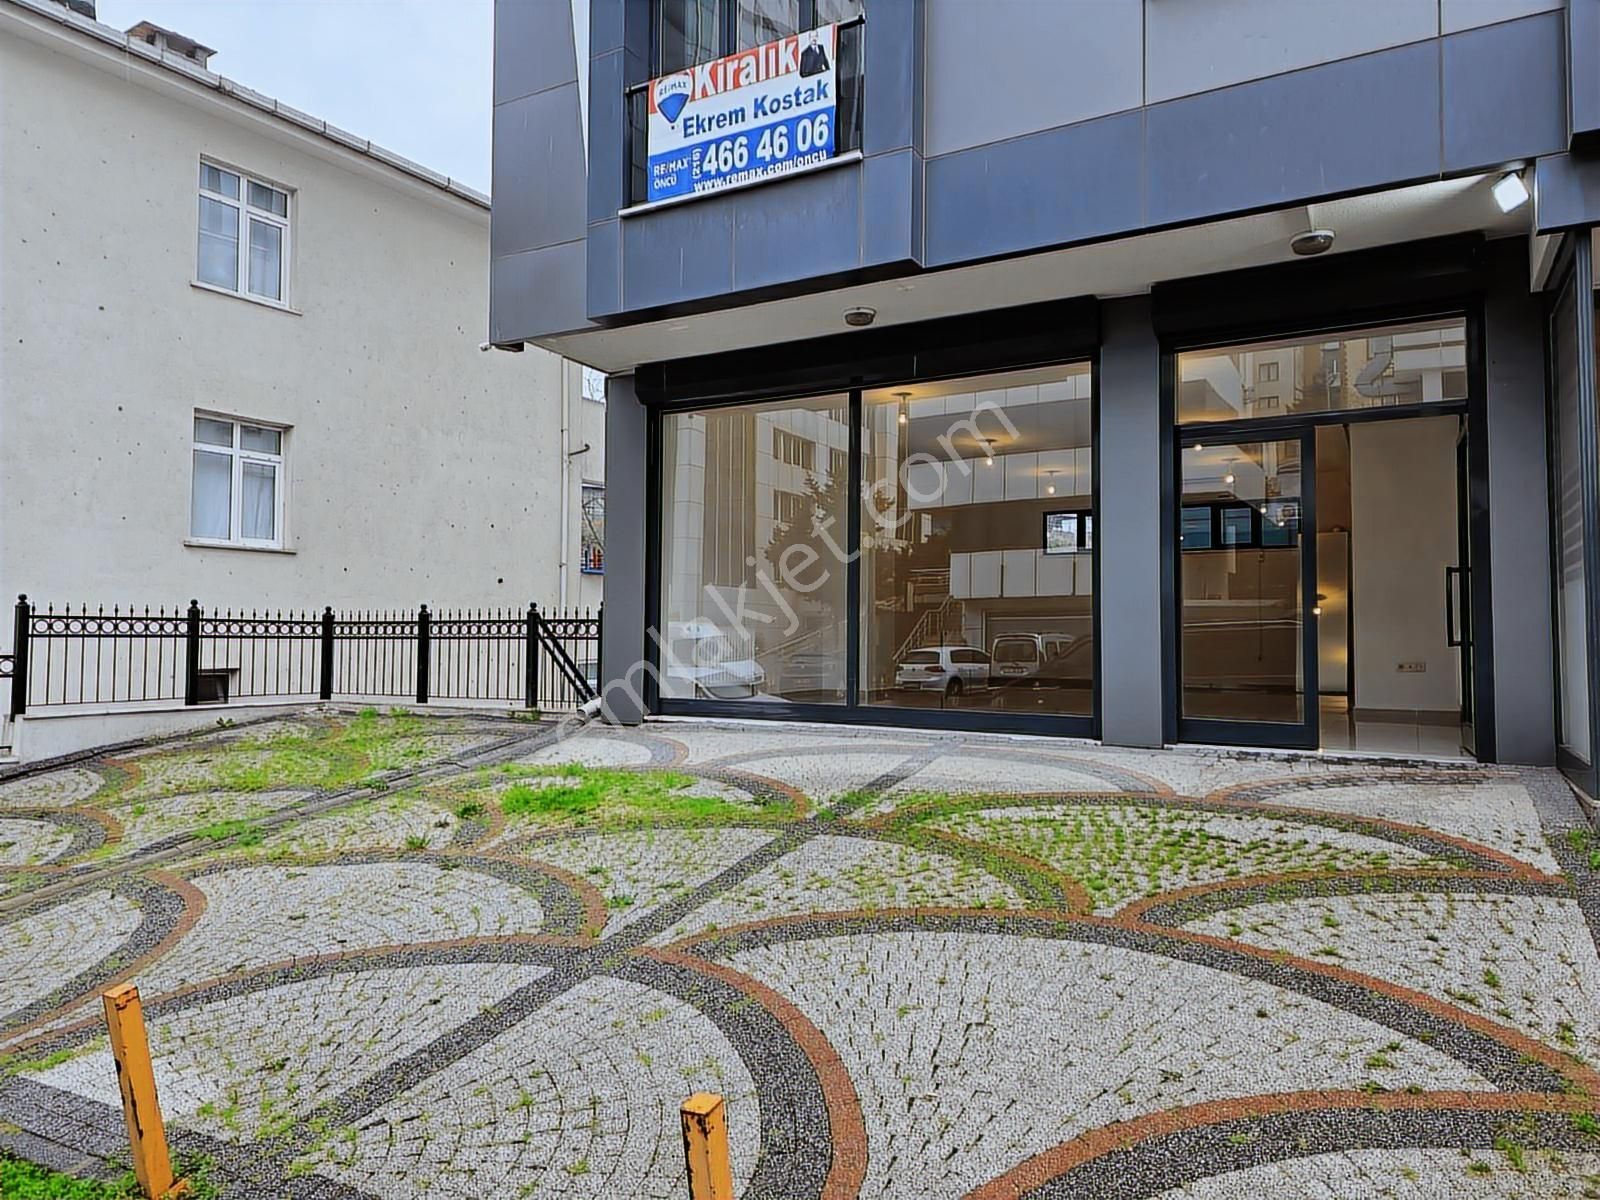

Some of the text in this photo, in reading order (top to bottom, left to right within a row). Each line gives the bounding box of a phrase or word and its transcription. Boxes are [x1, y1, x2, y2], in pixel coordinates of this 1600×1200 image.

[683, 79, 829, 138] Ekrem Kostak
[654, 157, 689, 177] RE/MAX
[703, 136, 749, 176] 466
[756, 125, 788, 162] 46
[796, 113, 829, 152] 06
[693, 150, 828, 193] www.remax.com/oncu
